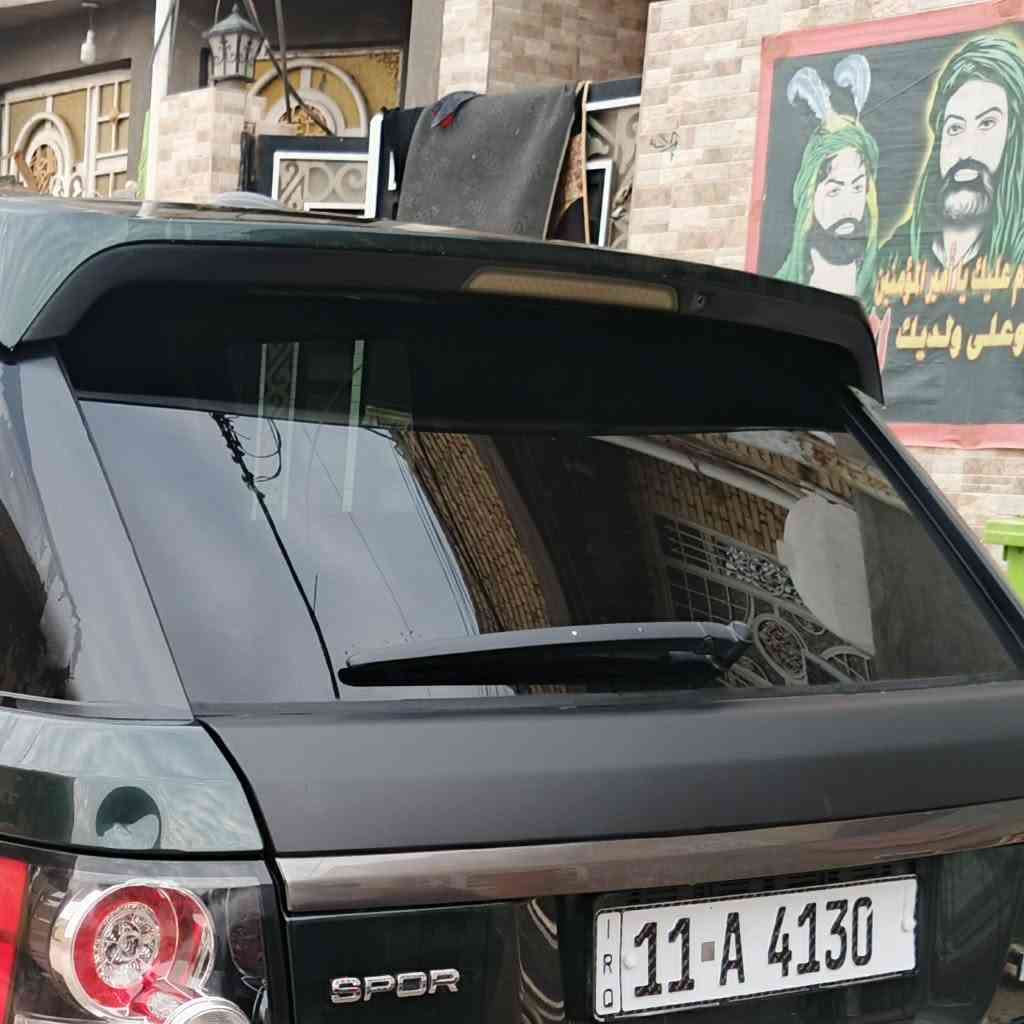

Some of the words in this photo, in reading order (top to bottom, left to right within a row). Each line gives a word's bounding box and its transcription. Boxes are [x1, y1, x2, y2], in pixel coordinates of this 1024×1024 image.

[634, 917, 695, 997] 11
[719, 912, 745, 986] A
[767, 897, 874, 977] 4130
[331, 968, 460, 1003] SPOR
